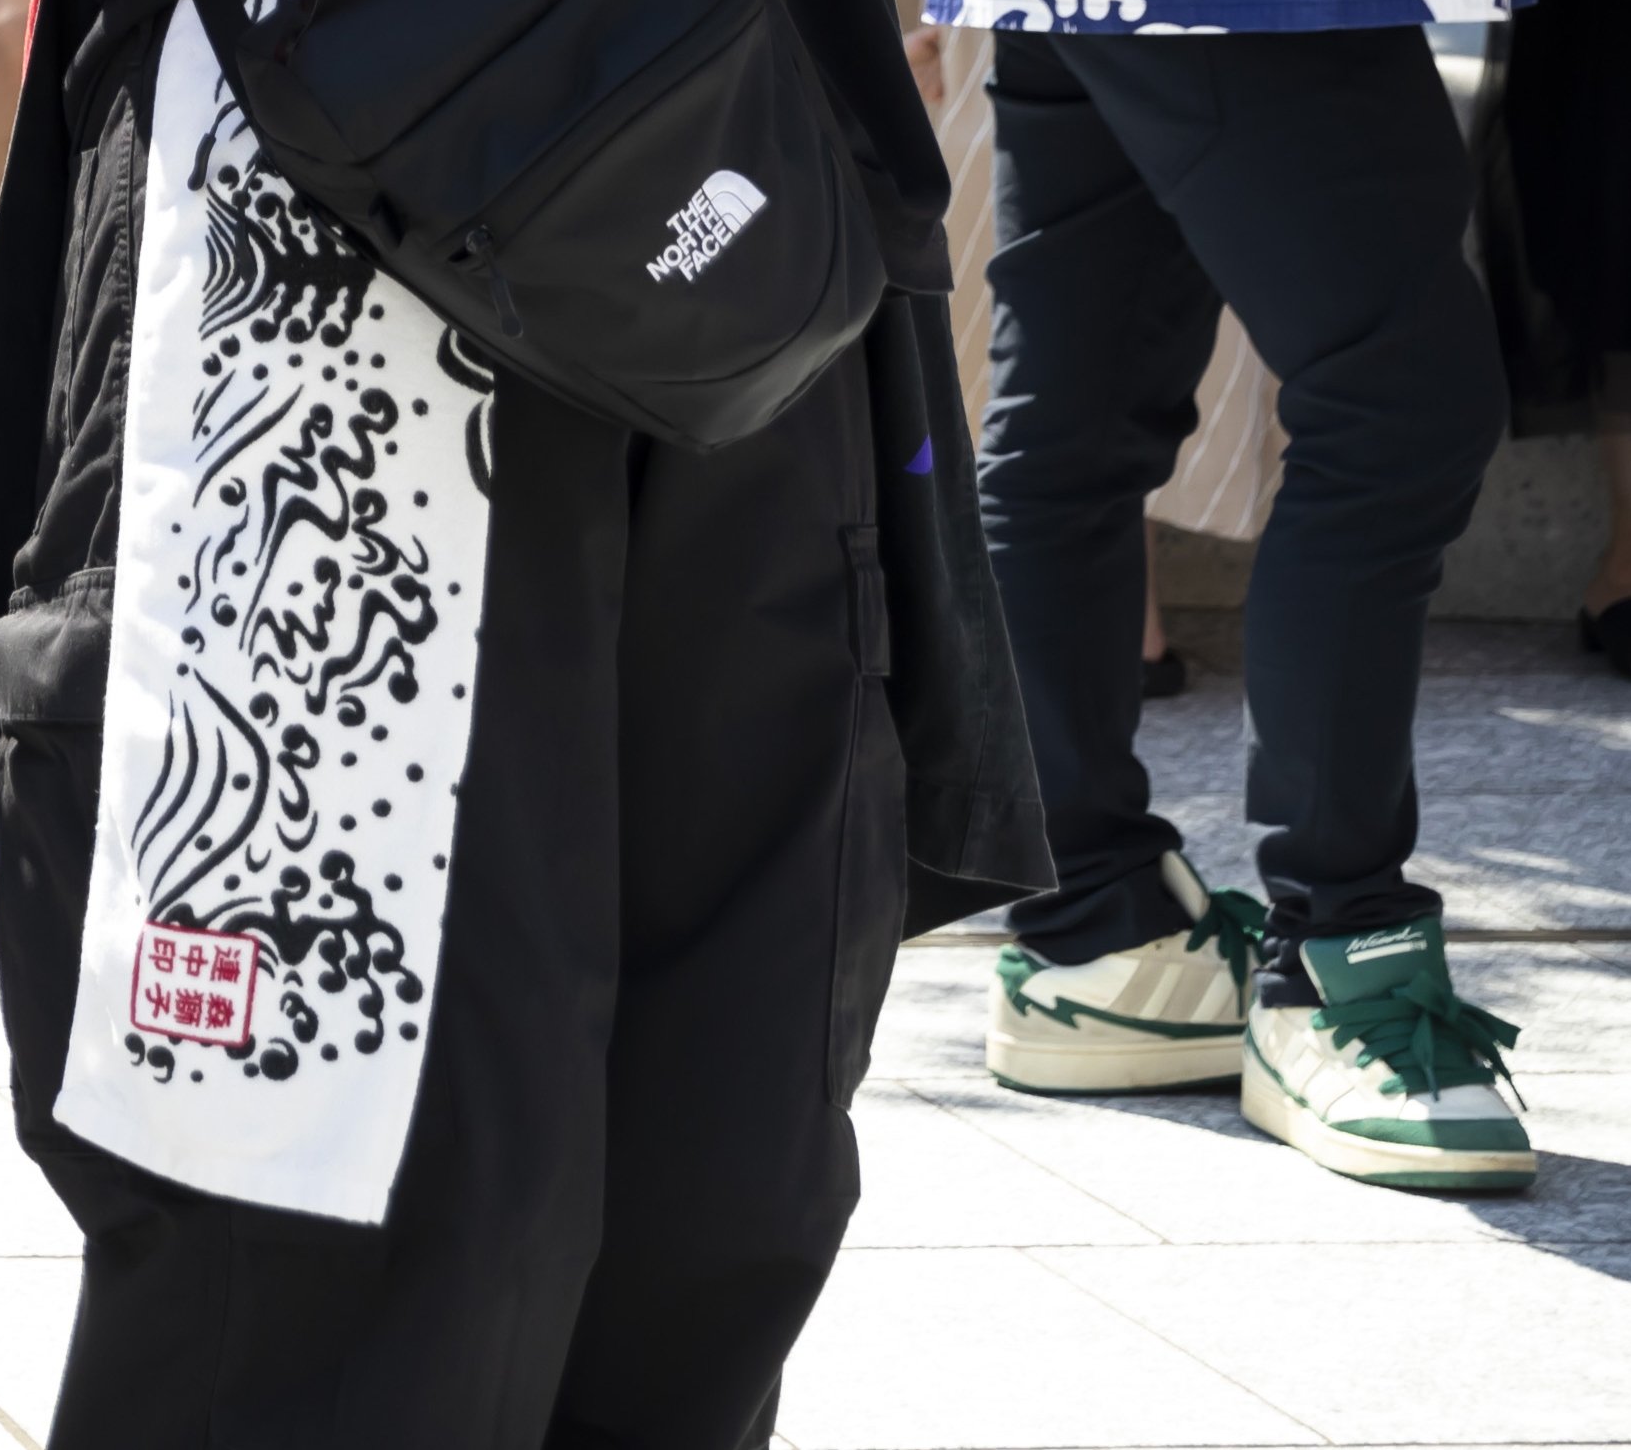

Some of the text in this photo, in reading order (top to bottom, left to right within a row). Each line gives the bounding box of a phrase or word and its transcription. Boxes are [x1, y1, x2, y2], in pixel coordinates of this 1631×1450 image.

[666, 188, 710, 235] THE
[646, 204, 721, 282] NORTH
[678, 219, 733, 282] FACE
[147, 937, 241, 984] 連中印
